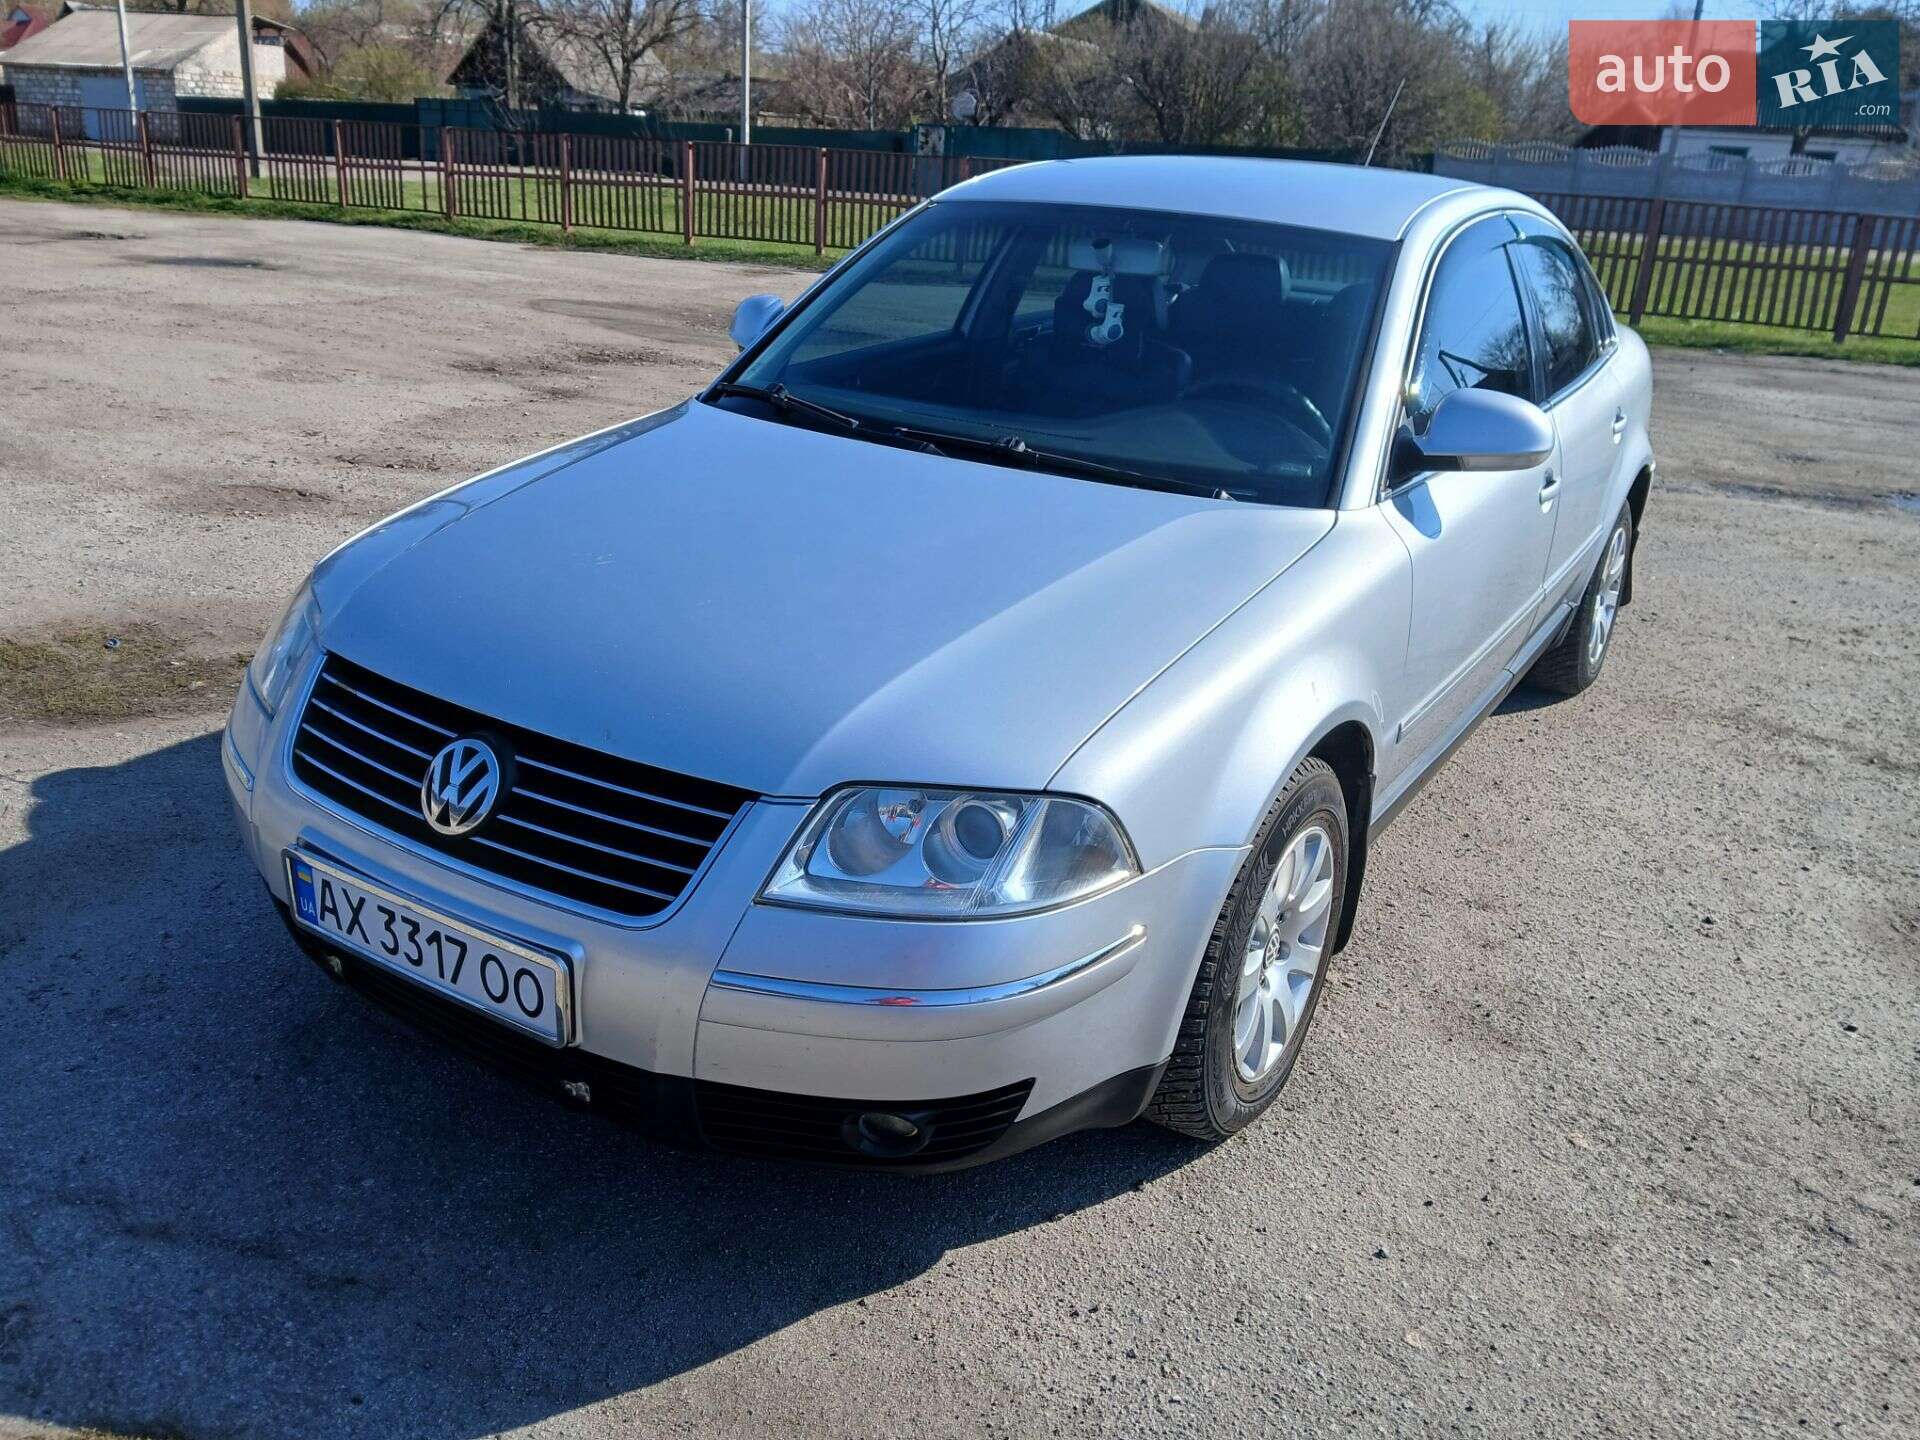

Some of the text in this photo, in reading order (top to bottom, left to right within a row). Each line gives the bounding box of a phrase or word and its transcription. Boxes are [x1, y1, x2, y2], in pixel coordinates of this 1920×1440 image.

[299, 896, 317, 918] UA
[319, 878, 371, 945] AX
[377, 904, 468, 985] 3317
